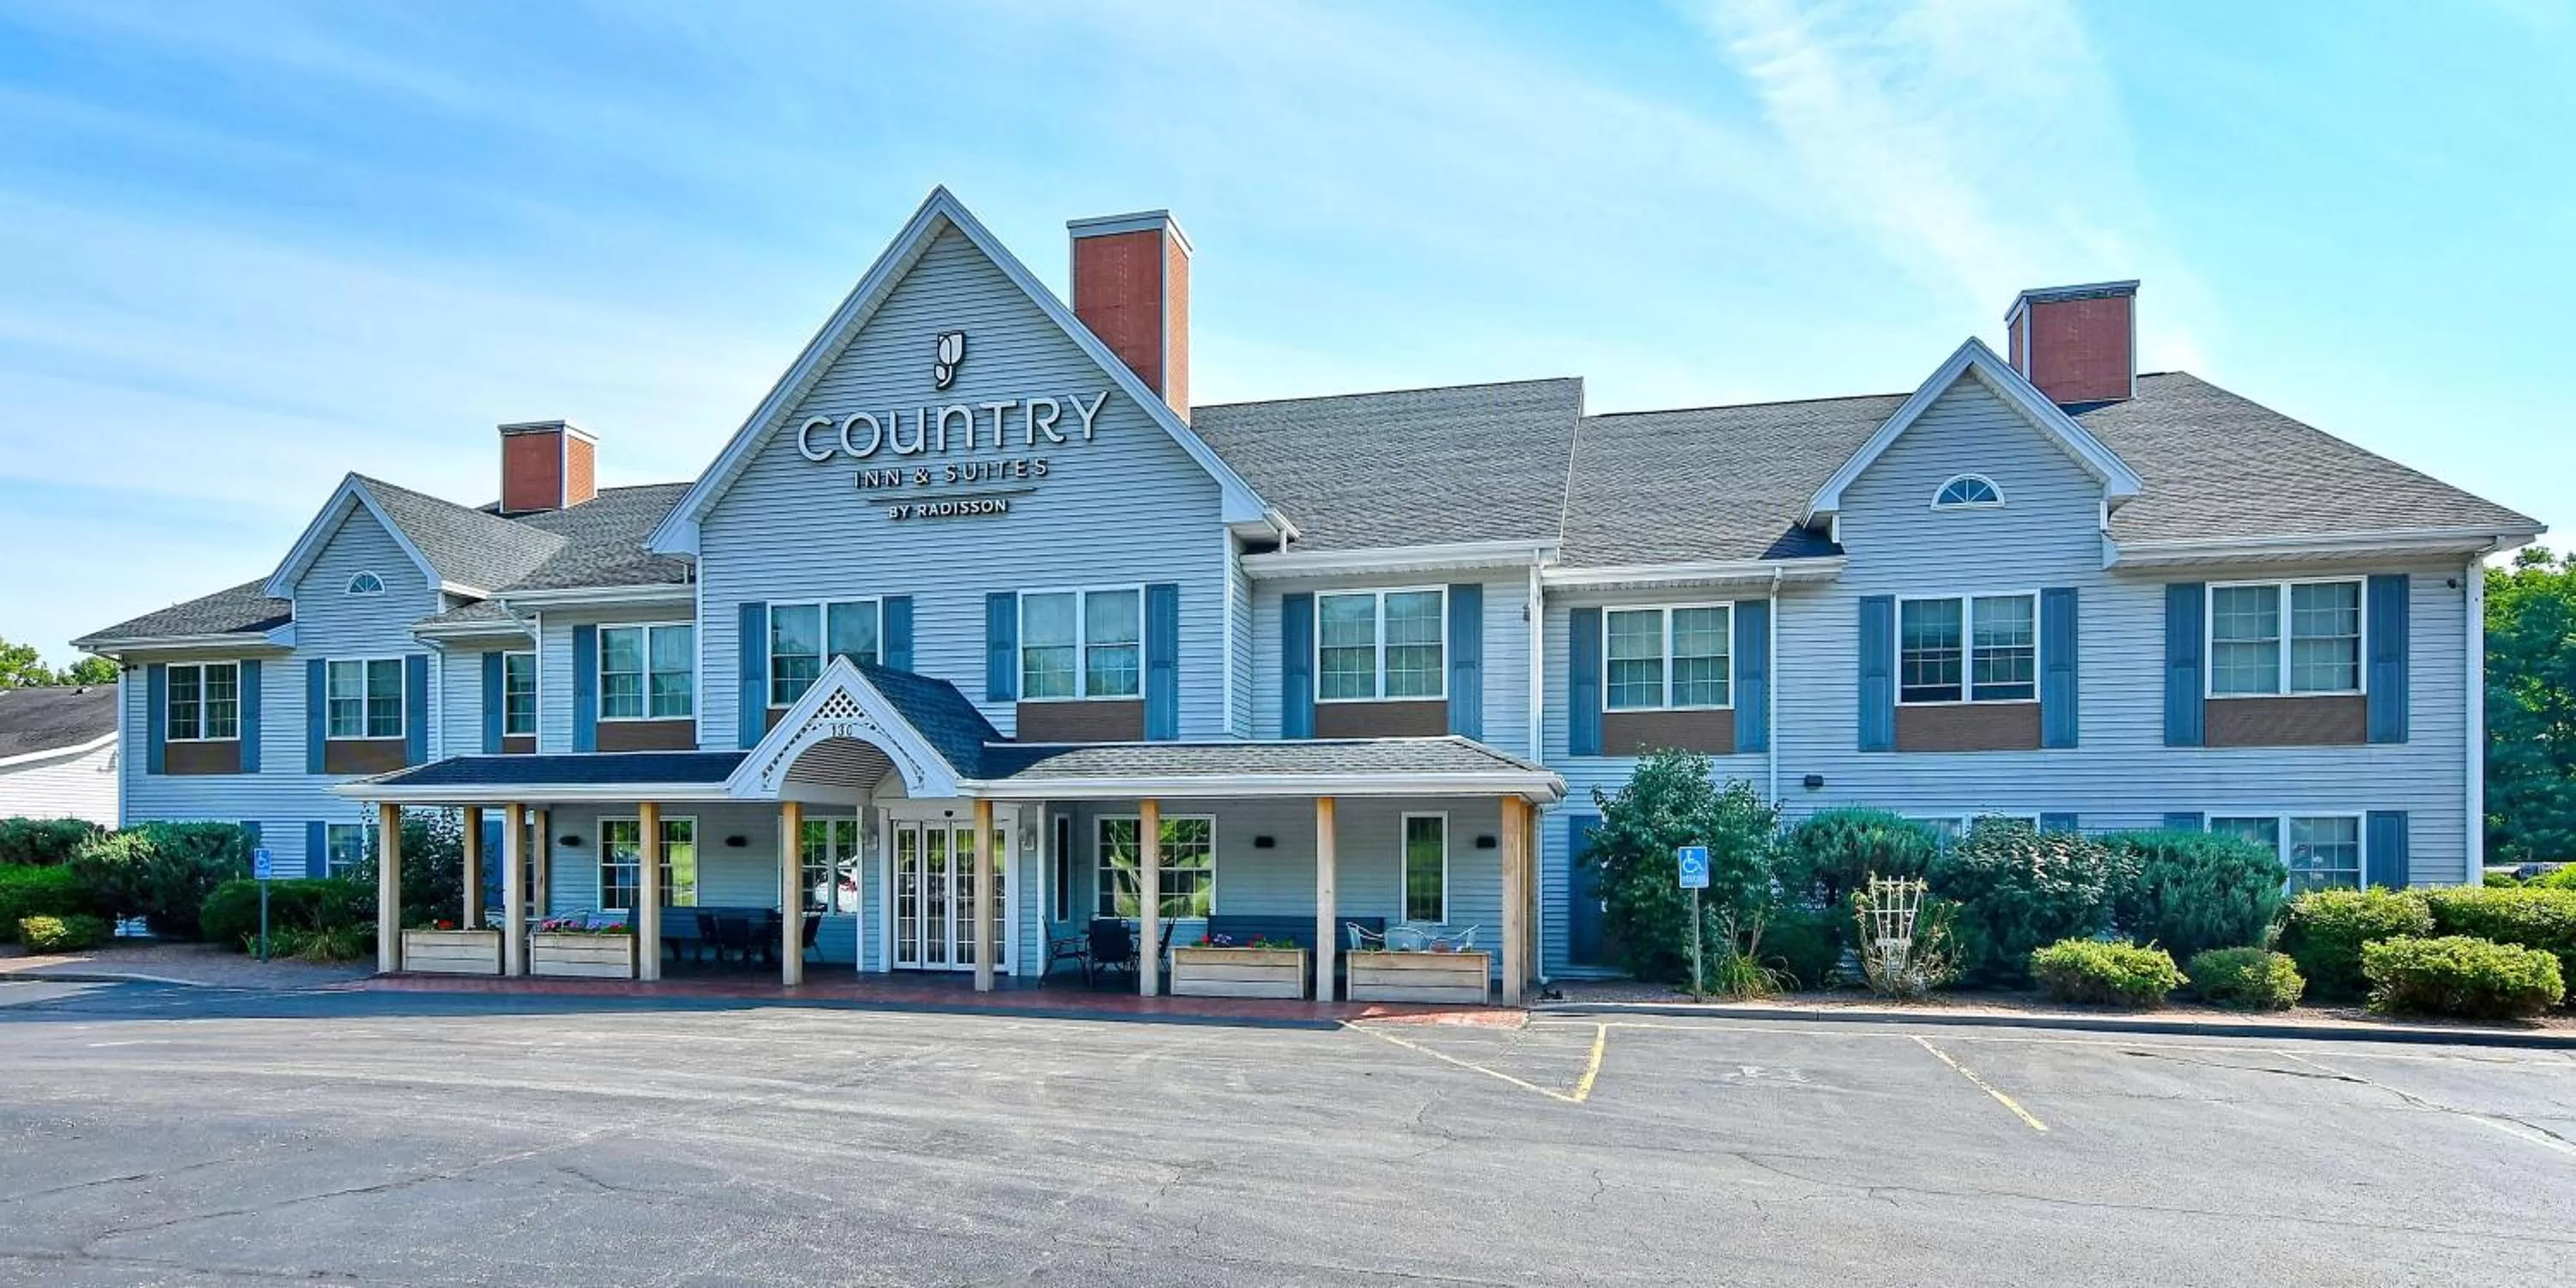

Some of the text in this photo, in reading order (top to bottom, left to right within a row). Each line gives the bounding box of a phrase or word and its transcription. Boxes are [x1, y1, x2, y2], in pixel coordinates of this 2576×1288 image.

[854, 457, 1049, 489] INN & SUITES
[889, 499, 1008, 519] BY RADISSON
